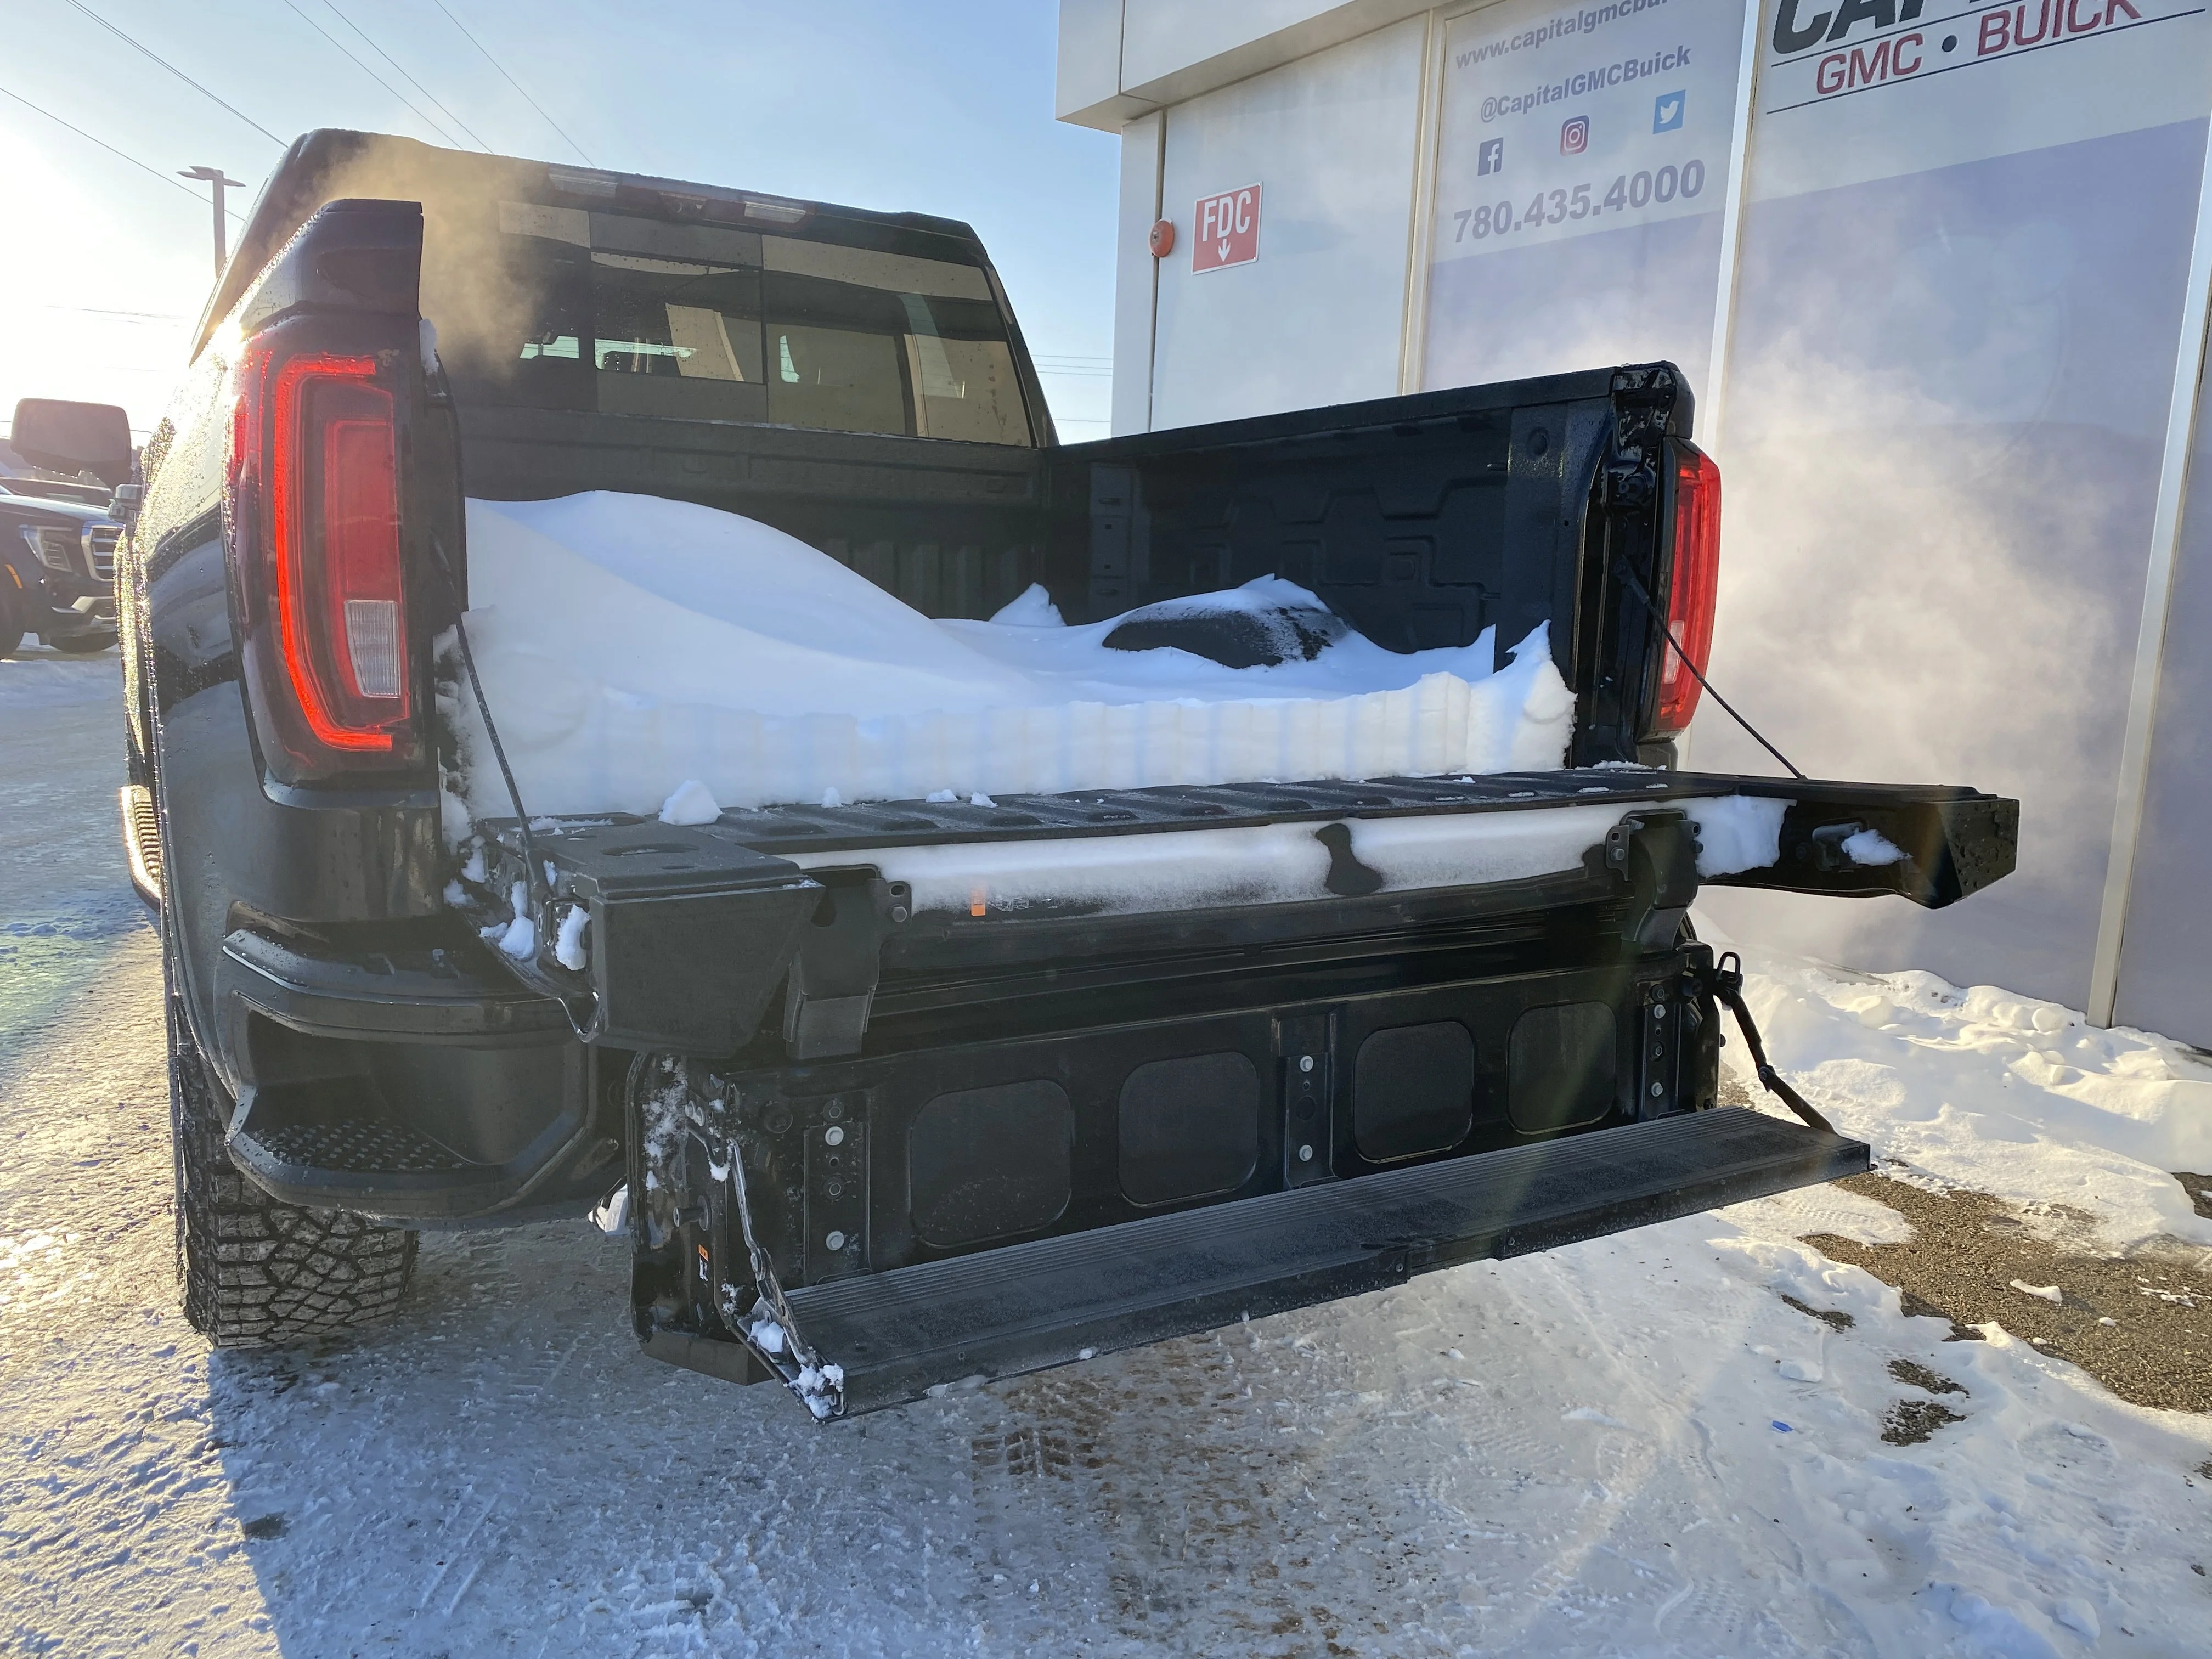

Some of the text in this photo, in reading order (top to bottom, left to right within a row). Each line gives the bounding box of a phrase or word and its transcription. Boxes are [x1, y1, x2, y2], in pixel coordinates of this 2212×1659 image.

[1455, 0, 1667, 69] www.capitalgmcb
[1816, 33, 1923, 94] GMC
[1481, 46, 1691, 122] @CapitalGMCBuick
[1203, 191, 1251, 242] FDC
[1454, 159, 1705, 242] 780.435.4000
